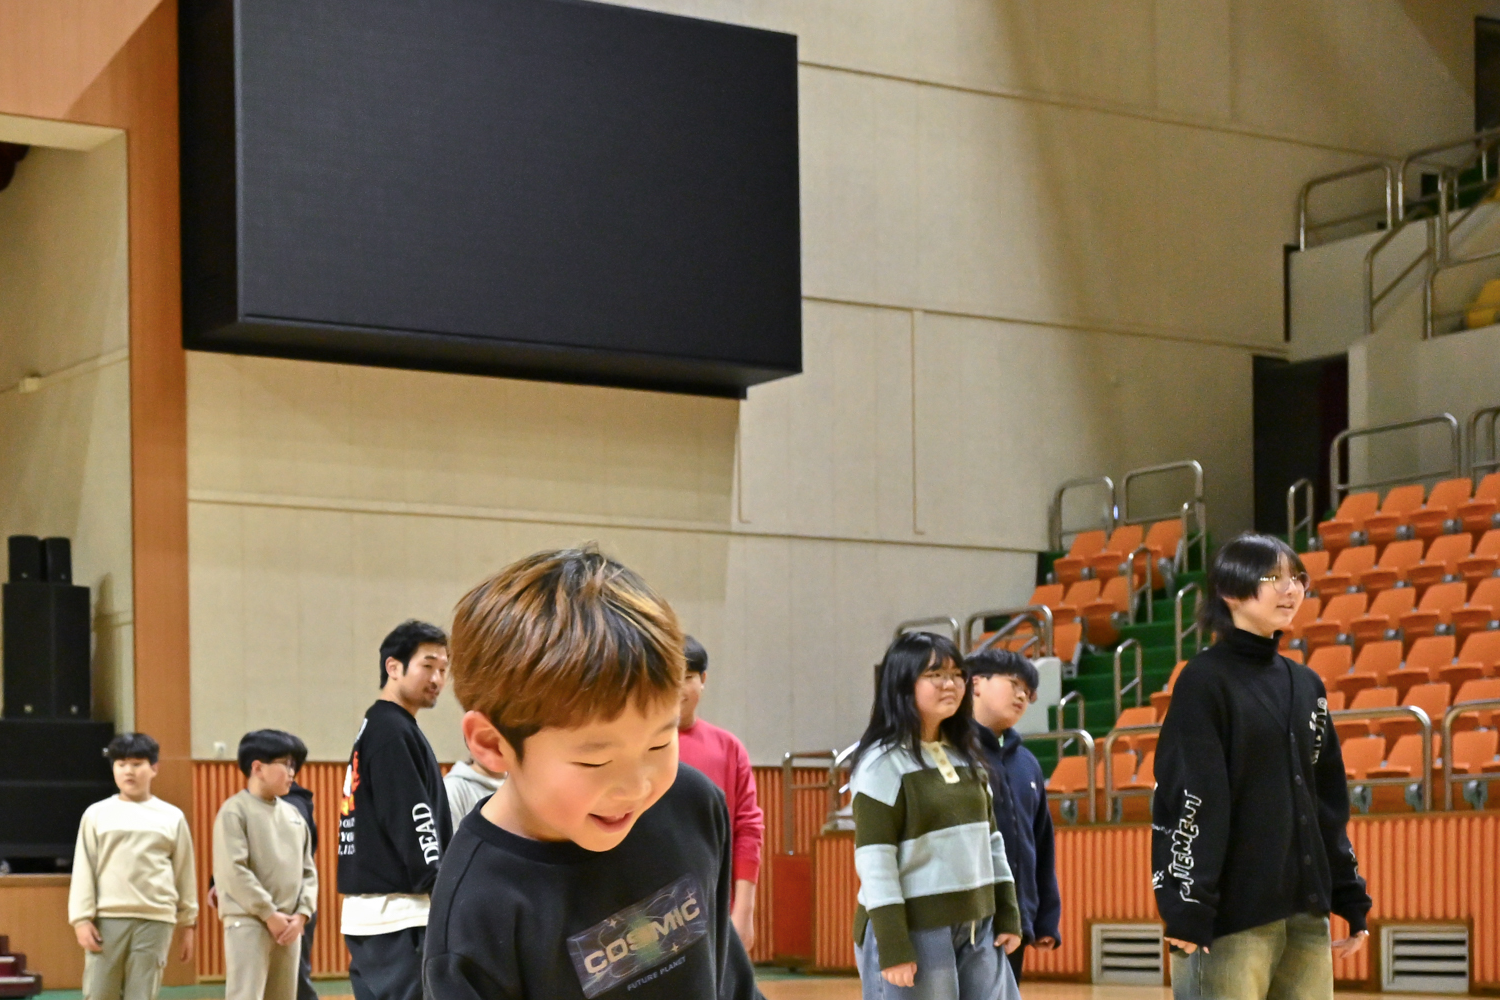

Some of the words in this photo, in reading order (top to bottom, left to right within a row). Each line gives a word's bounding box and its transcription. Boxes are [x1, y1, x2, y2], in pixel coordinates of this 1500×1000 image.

[412, 802, 440, 865] DEAD
[584, 898, 700, 974] COSMIC
[627, 971, 659, 991] FUTURE
[659, 955, 686, 975] PLANET
